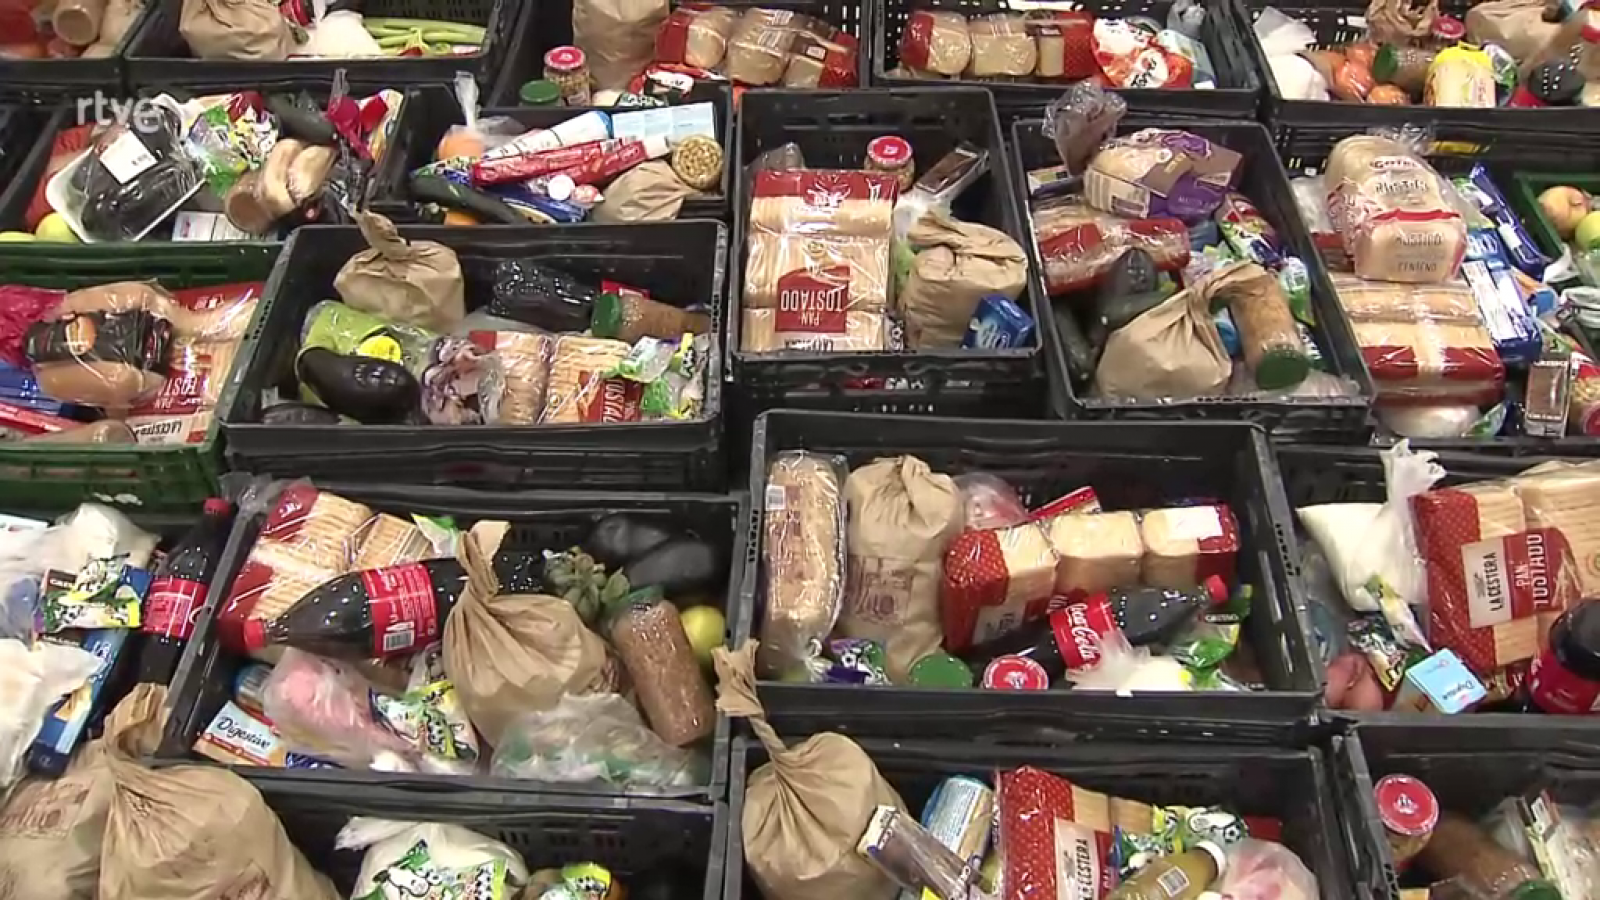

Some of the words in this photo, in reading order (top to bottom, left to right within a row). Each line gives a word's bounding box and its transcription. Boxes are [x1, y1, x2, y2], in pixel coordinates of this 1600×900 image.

[781, 289, 844, 311] TOSTADO
[801, 311, 820, 325] PAN
[1482, 552, 1502, 597] CESTERA
[1515, 563, 1531, 588] PAN
[1490, 597, 1503, 612] LA
[216, 716, 271, 749] Digestive
[1076, 839, 1093, 886] CESTERA
